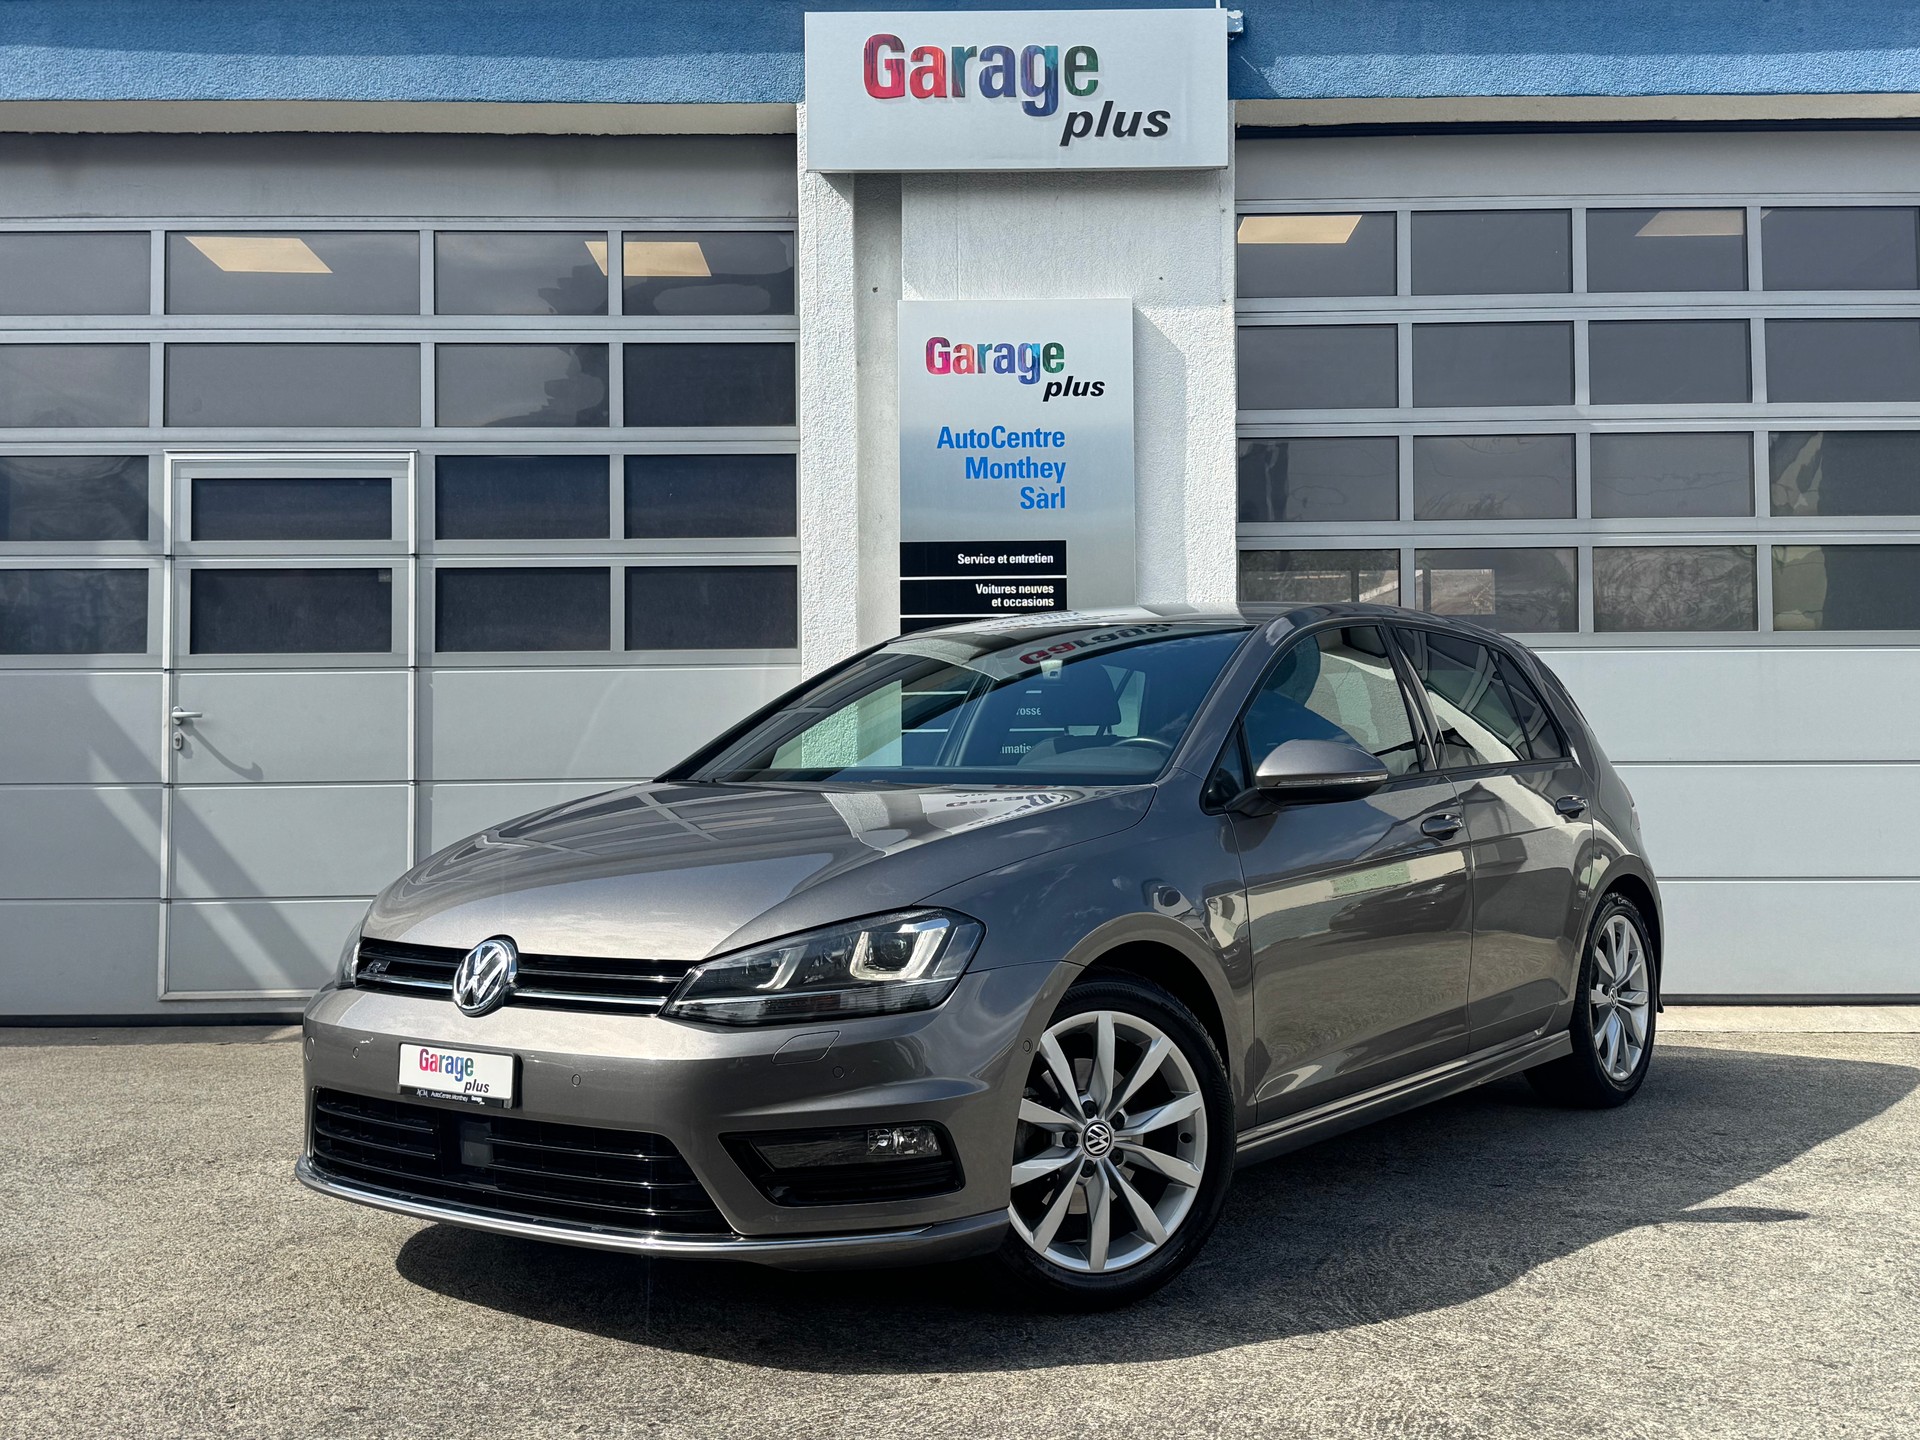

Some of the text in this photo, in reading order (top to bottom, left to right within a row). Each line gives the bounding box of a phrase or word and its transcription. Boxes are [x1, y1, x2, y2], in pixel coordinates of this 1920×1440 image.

[863, 34, 1099, 117] Garage
[1059, 100, 1171, 146] plus
[925, 336, 1065, 385] Garage
[1043, 375, 1106, 402] plus
[936, 425, 1066, 450] AutoCentre
[965, 456, 1067, 484] Monthey
[1020, 486, 1066, 510] Sàrl
[957, 553, 1054, 565] Service et entretien
[975, 583, 1055, 595] Voitures neuves
[991, 596, 1055, 607] et occasions
[419, 1048, 474, 1082] Garage
[463, 1078, 490, 1093] plus
